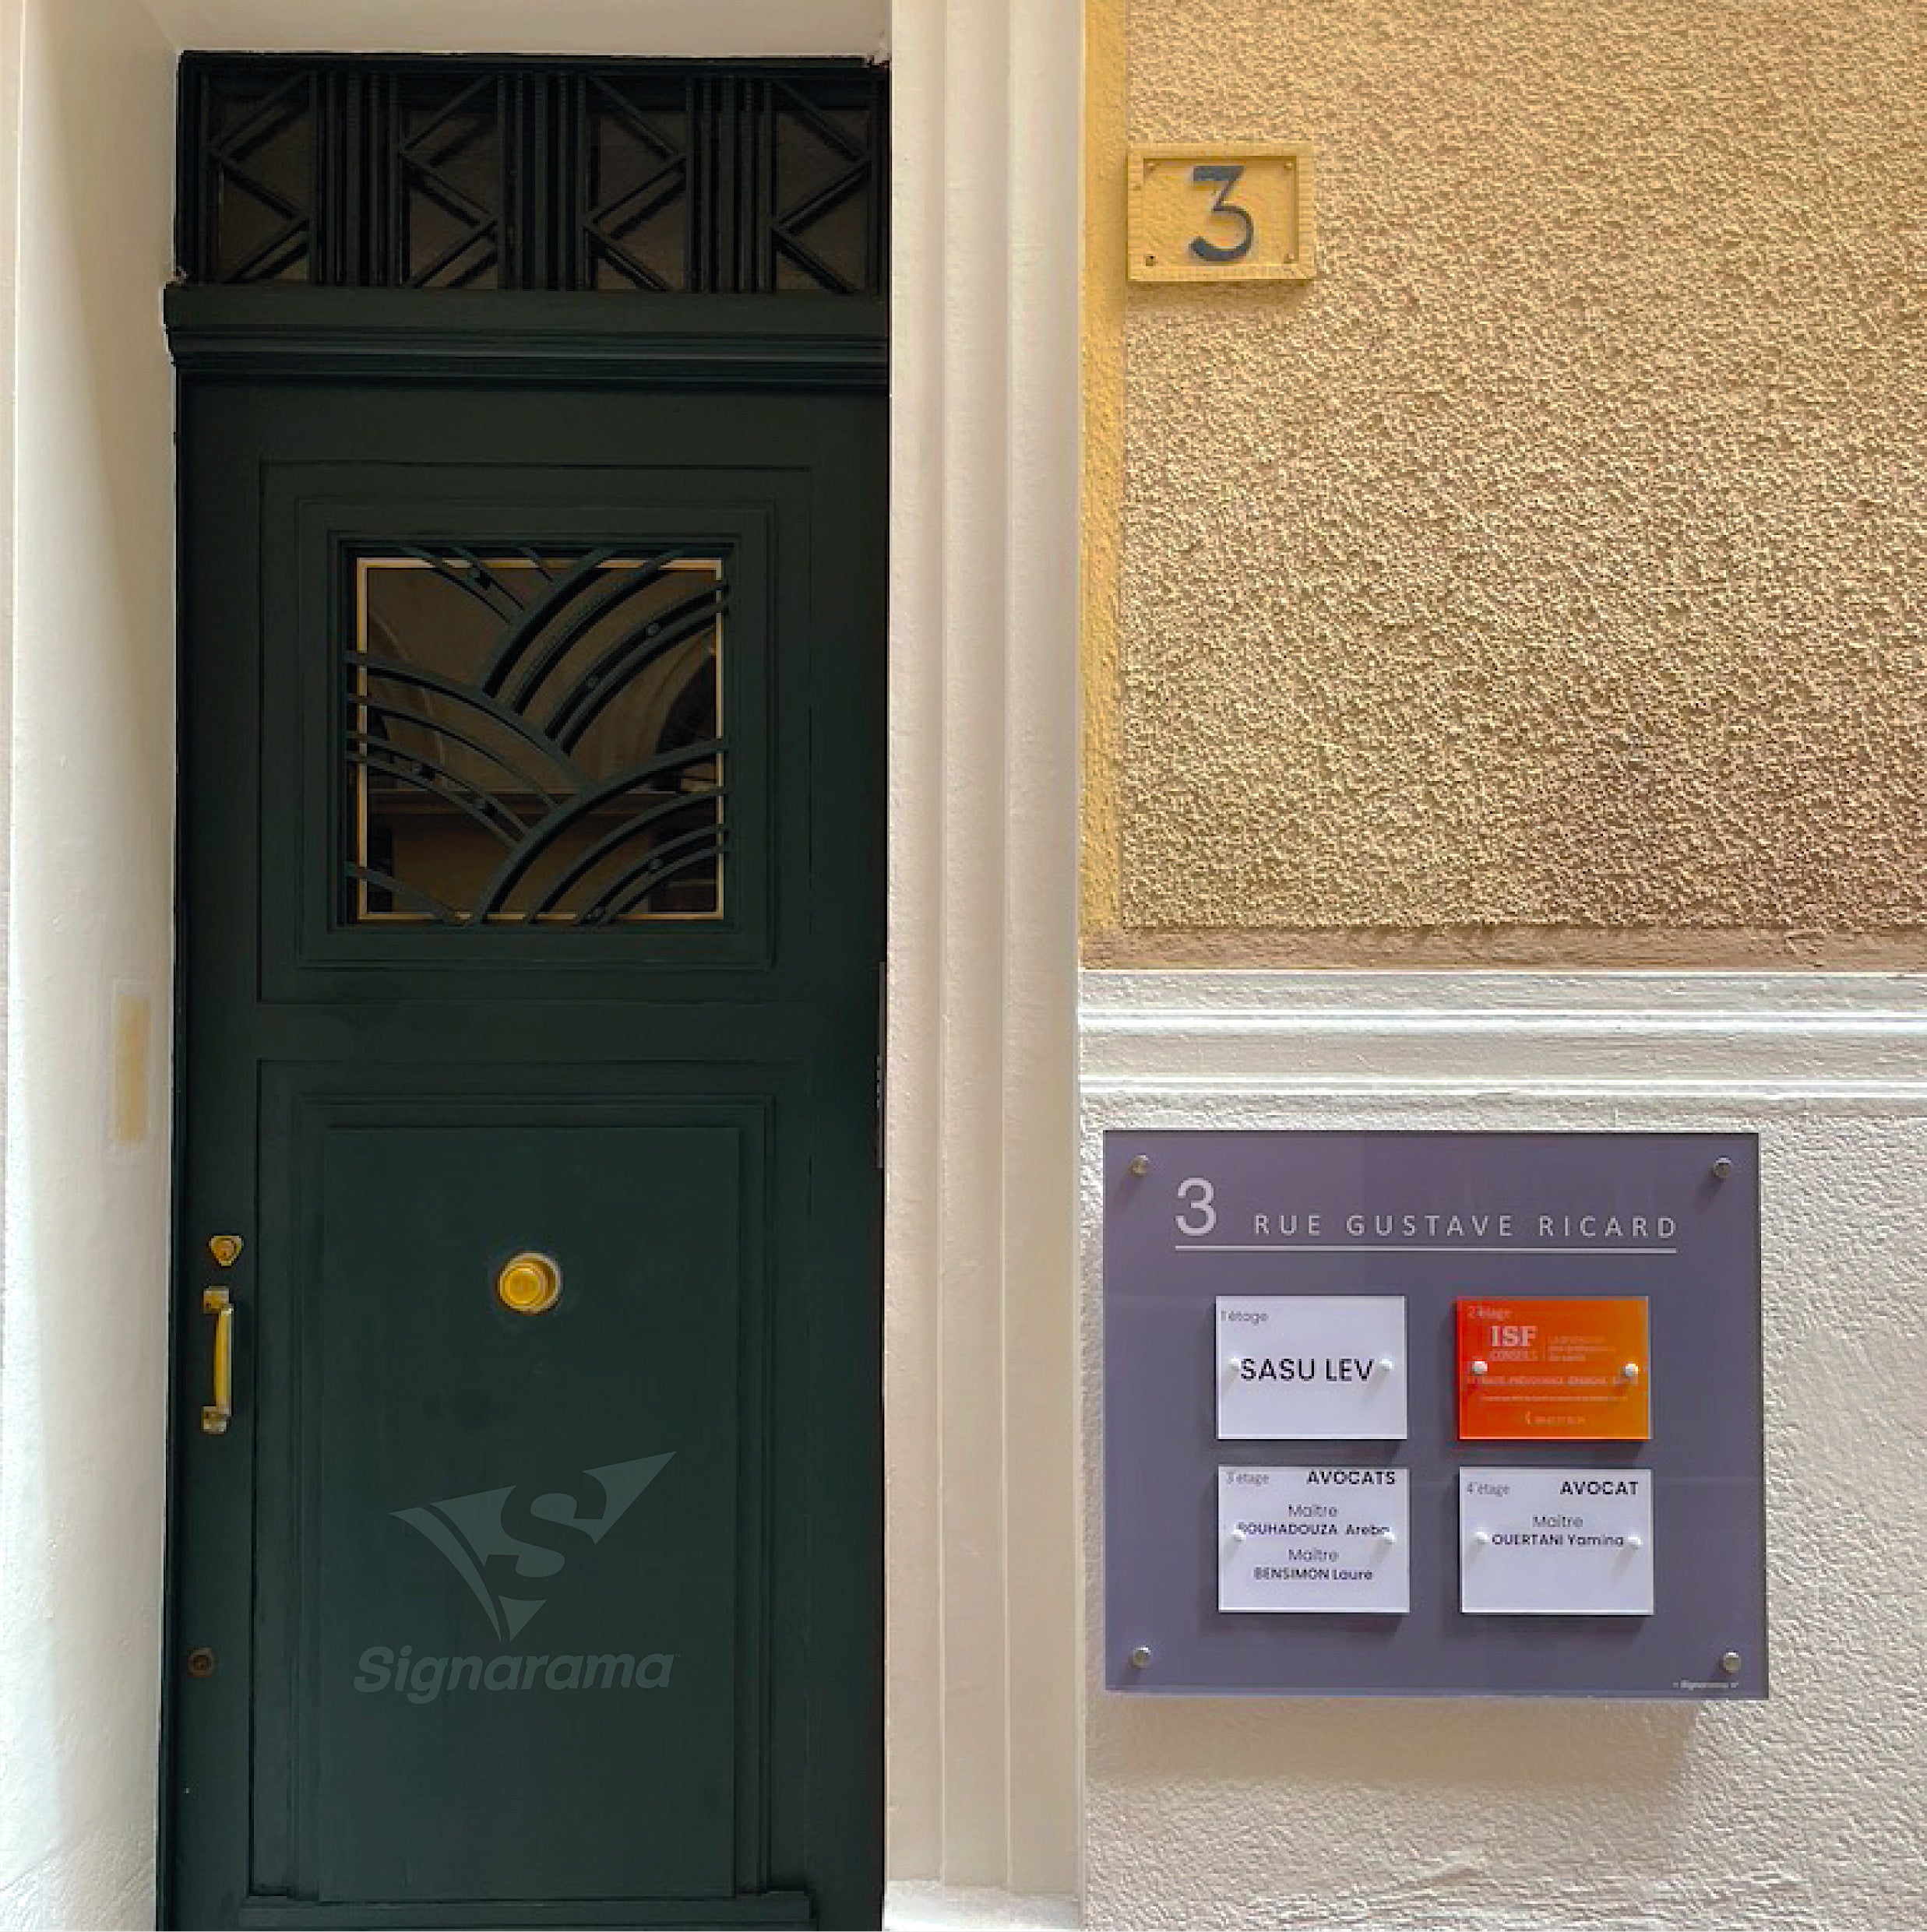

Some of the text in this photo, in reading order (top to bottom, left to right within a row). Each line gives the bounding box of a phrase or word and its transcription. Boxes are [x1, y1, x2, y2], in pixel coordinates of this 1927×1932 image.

[1189, 165, 1254, 262] 3
[1175, 1177, 1678, 1239] 3 RUE GUSTAVE RICARD
[1491, 1325, 1538, 1347] ISF
[1241, 1358, 1375, 1382] SASU LEV
[1305, 1470, 1397, 1485] AVOCATS
[1559, 1480, 1640, 1495] AVOCAT
[1288, 1503, 1340, 1518] Maître
[1531, 1514, 1584, 1529] Maître
[1491, 1533, 1564, 1546] OUERTANI
[1288, 1547, 1340, 1562] Maître
[1253, 1566, 1373, 1581] BENSIMON Laure
